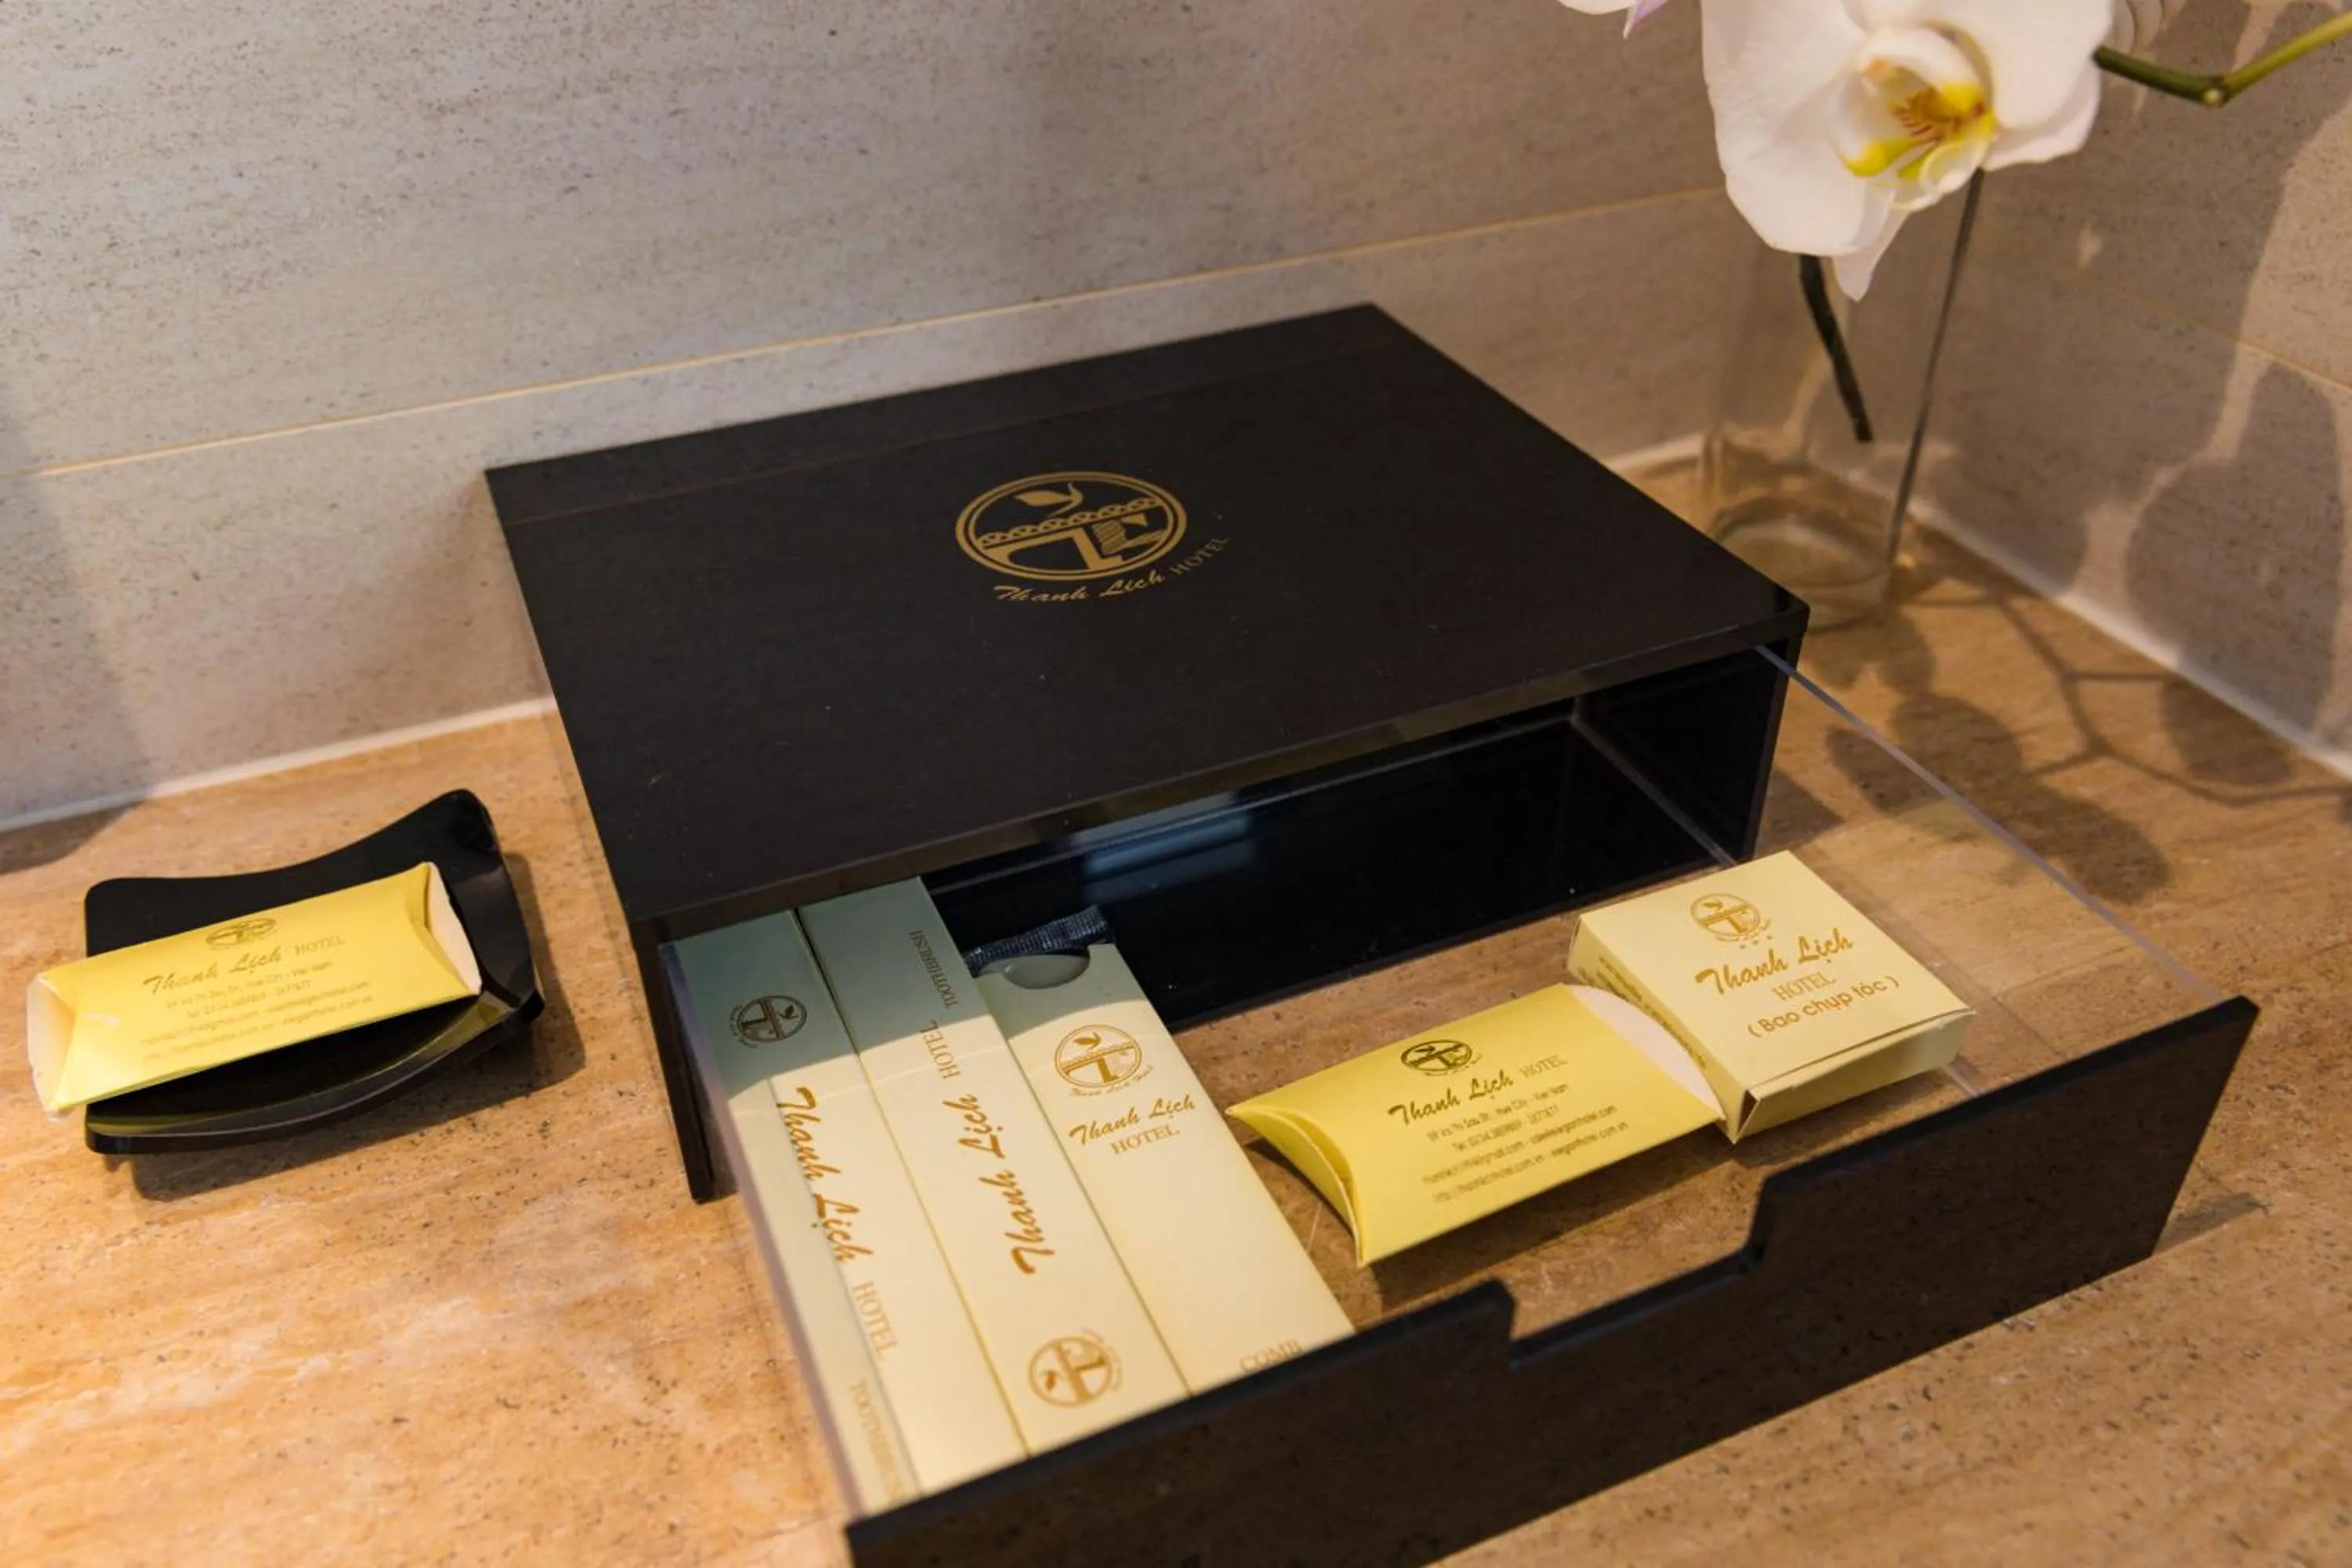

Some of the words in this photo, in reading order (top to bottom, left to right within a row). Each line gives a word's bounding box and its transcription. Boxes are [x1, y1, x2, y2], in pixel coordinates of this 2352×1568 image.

[993, 585, 1089, 602] Thanh
[1172, 535, 1231, 575] HOTEL
[143, 961, 219, 996] Thanh
[295, 935, 347, 956] HOTEL
[909, 929, 959, 1009] TOOTHBRUSH
[1694, 948, 1789, 995] Thanh
[1798, 927, 1853, 964] Lịch
[1772, 971, 1837, 1000] HOTEL
[920, 1019, 962, 1079] HOTEL
[1387, 1089, 1461, 1127] Thanh
[1468, 1069, 1515, 1100] Lịch
[1519, 1054, 1570, 1080] HOTEL
[1069, 1106, 1140, 1145] Thanh
[1110, 1123, 1181, 1155] HOTEL
[776, 1086, 843, 1181] Thanh
[852, 1280, 898, 1358] HOTEL
[978, 1171, 1055, 1275] Thanh
